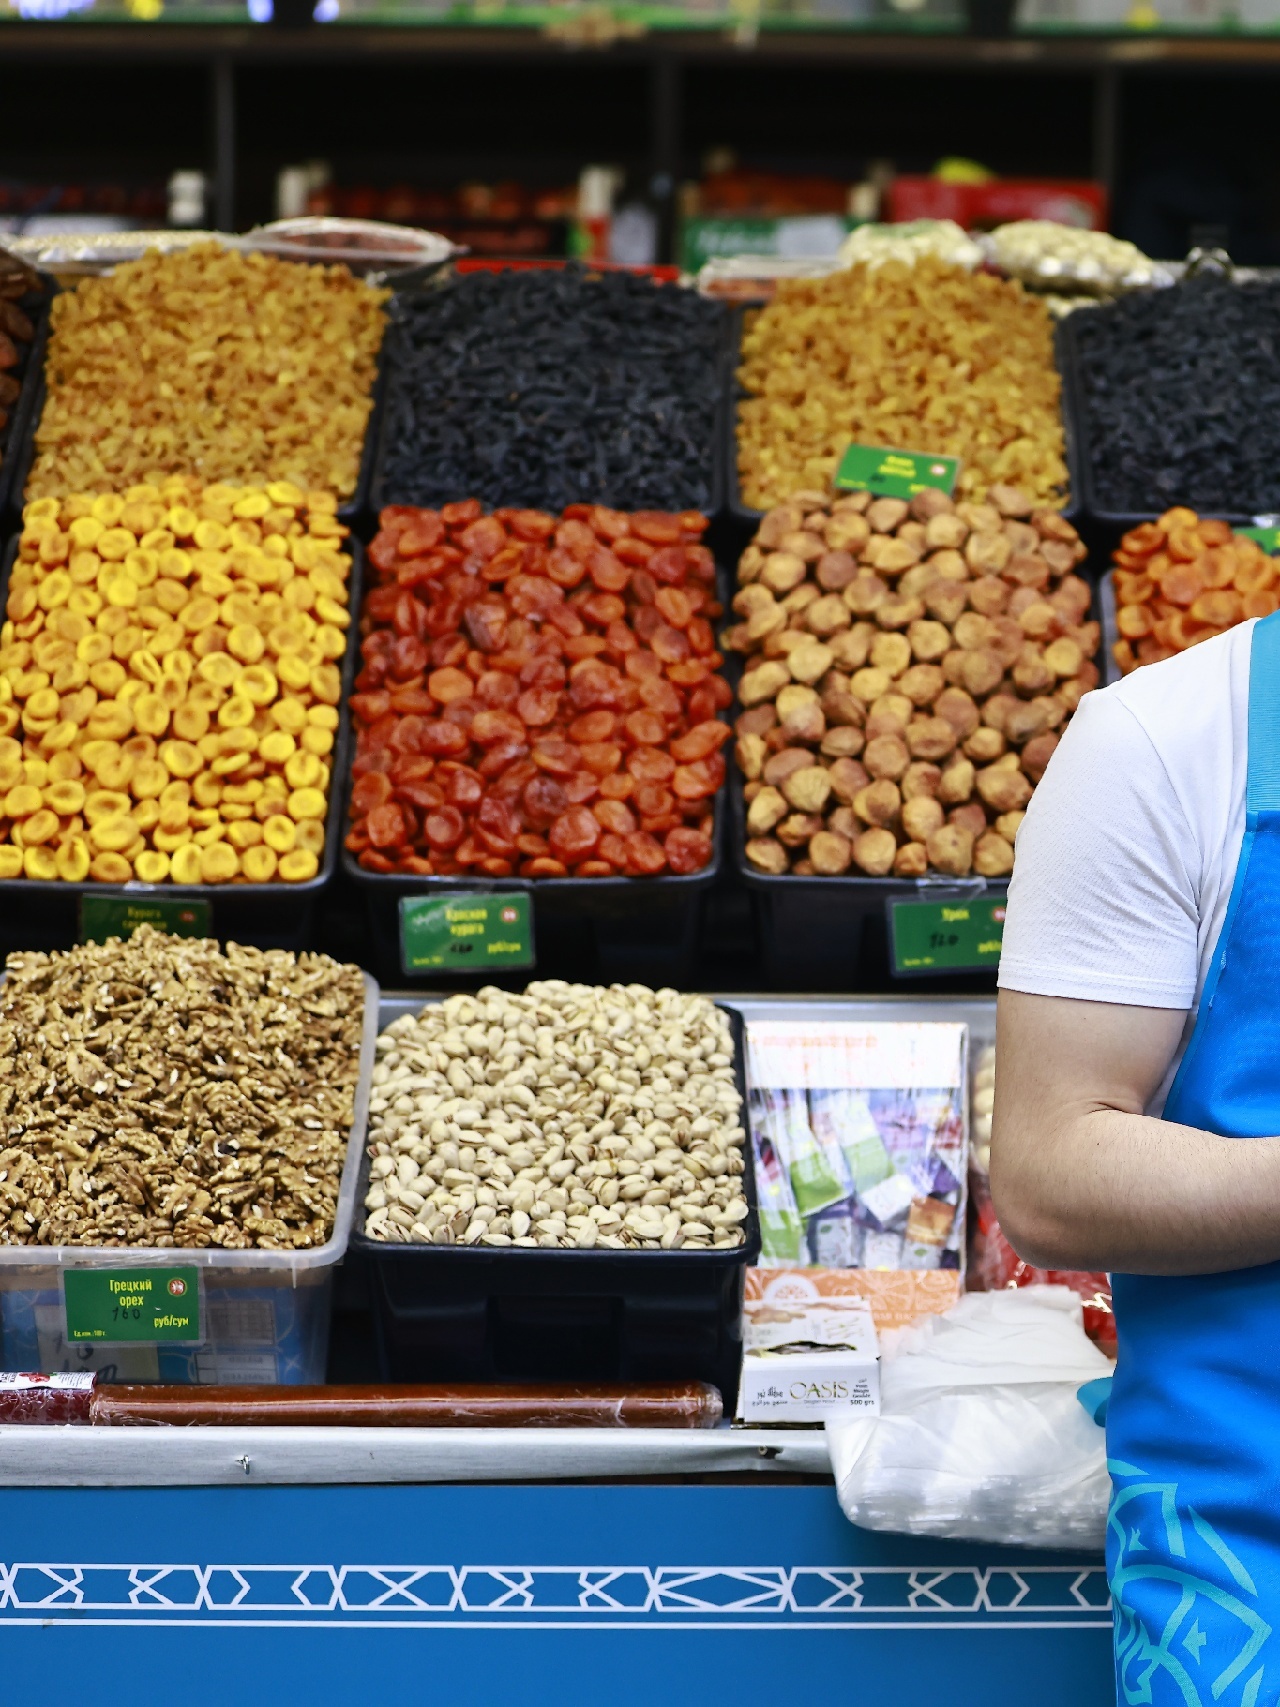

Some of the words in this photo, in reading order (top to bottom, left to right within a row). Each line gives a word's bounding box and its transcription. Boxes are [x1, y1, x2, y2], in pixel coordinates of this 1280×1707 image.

[109, 1279, 153, 1294] Грецкий
[119, 1295, 144, 1309] орех
[112, 1306, 141, 1321] 160
[153, 1314, 190, 1328] руб/сум
[789, 1380, 850, 1400] OASIS
